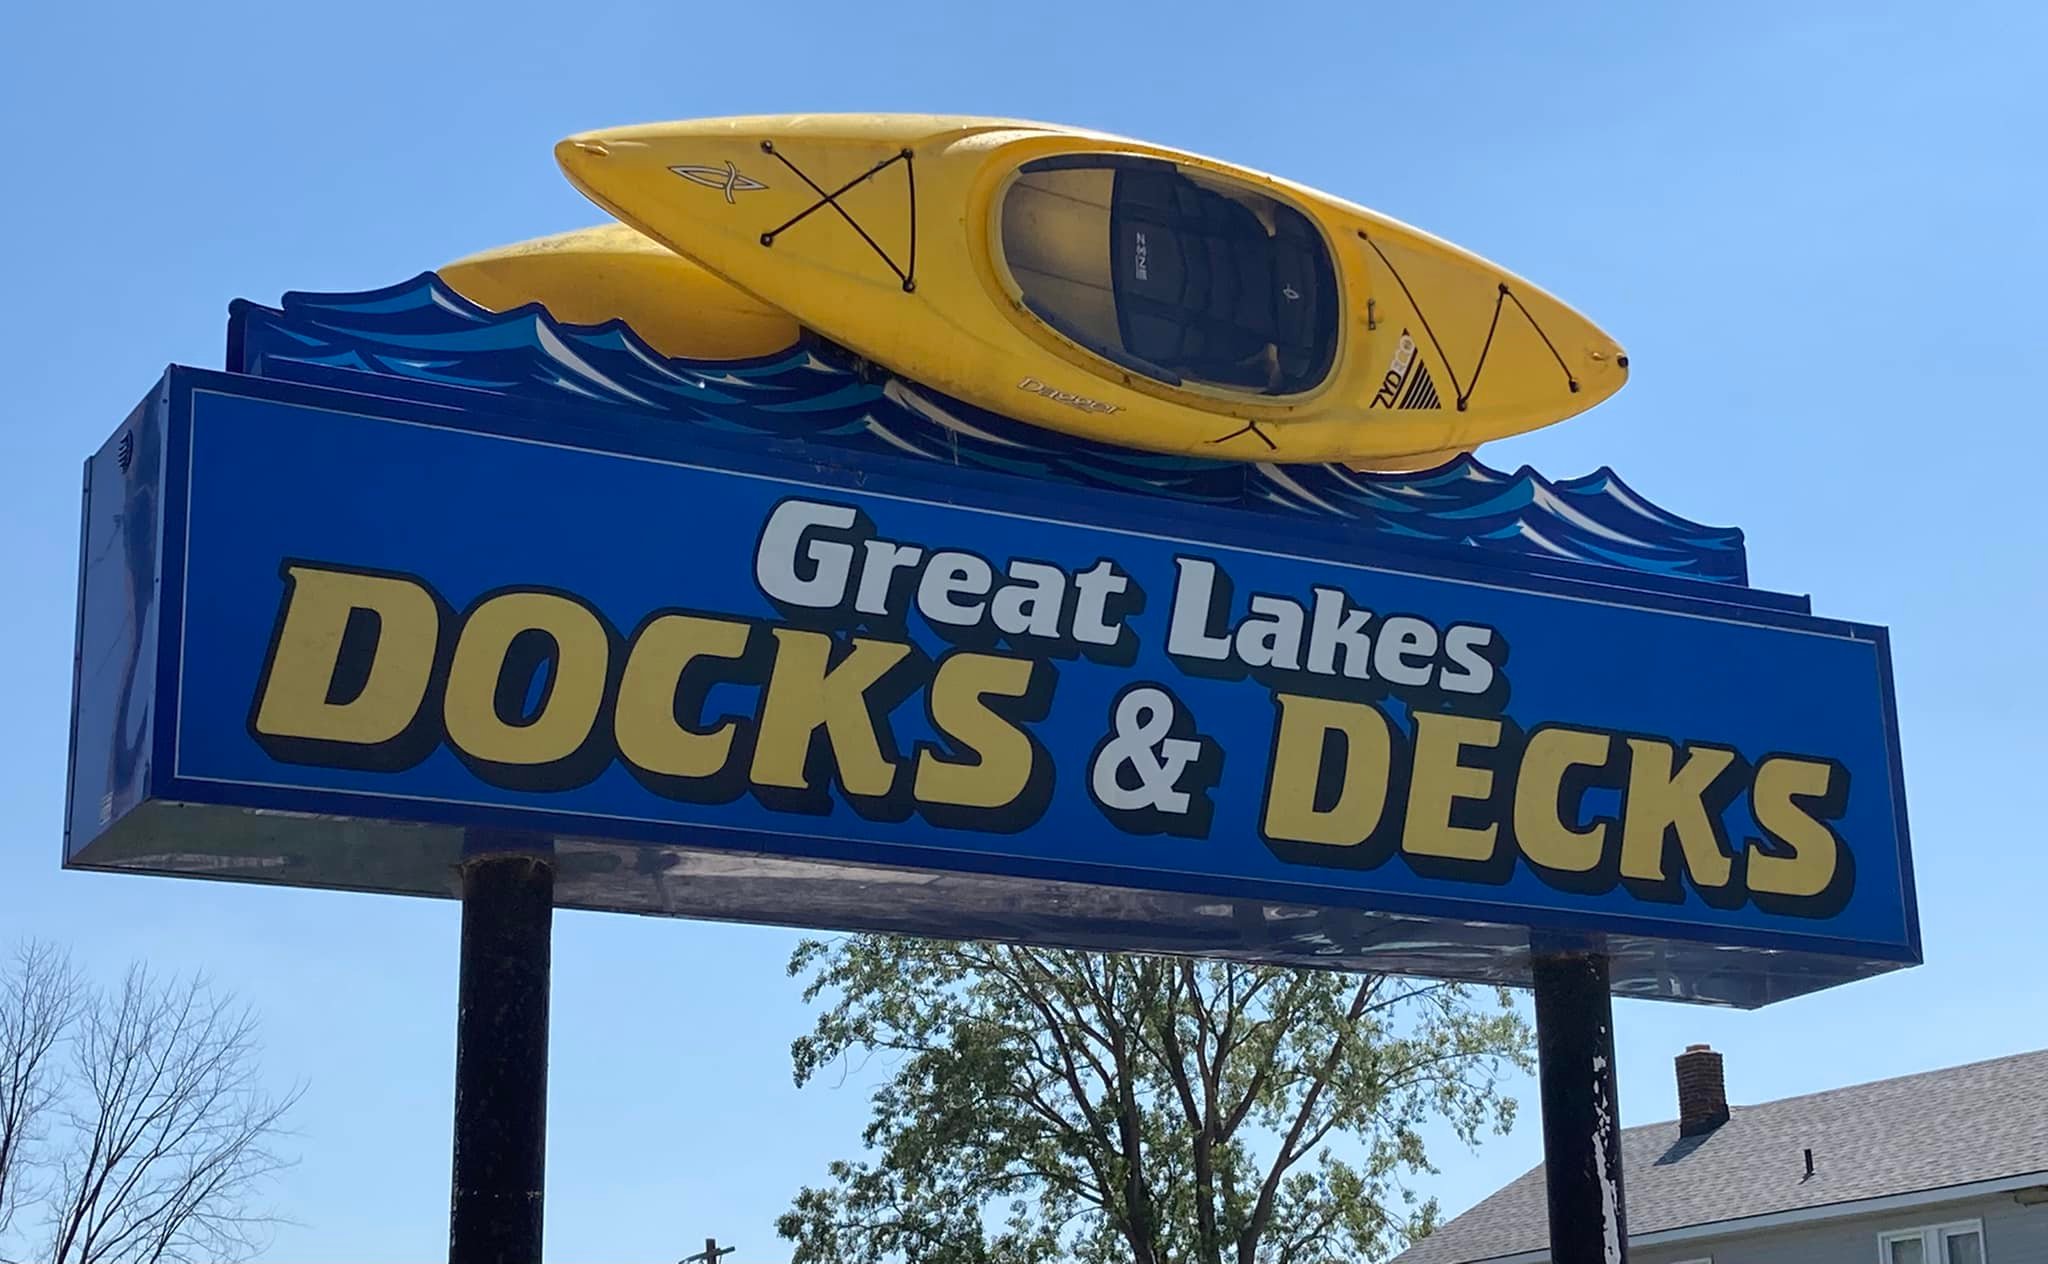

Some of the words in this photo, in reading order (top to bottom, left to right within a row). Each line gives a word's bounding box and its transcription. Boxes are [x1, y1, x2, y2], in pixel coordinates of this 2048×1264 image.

[1016, 376, 1127, 415] Dagger
[1369, 335, 1415, 409] ZYDECO
[755, 499, 1128, 646] Great
[1167, 557, 1494, 695] Lakes
[254, 565, 1035, 809] DOCKS
[1092, 687, 1202, 814] &
[1263, 692, 1833, 897] DECKS
